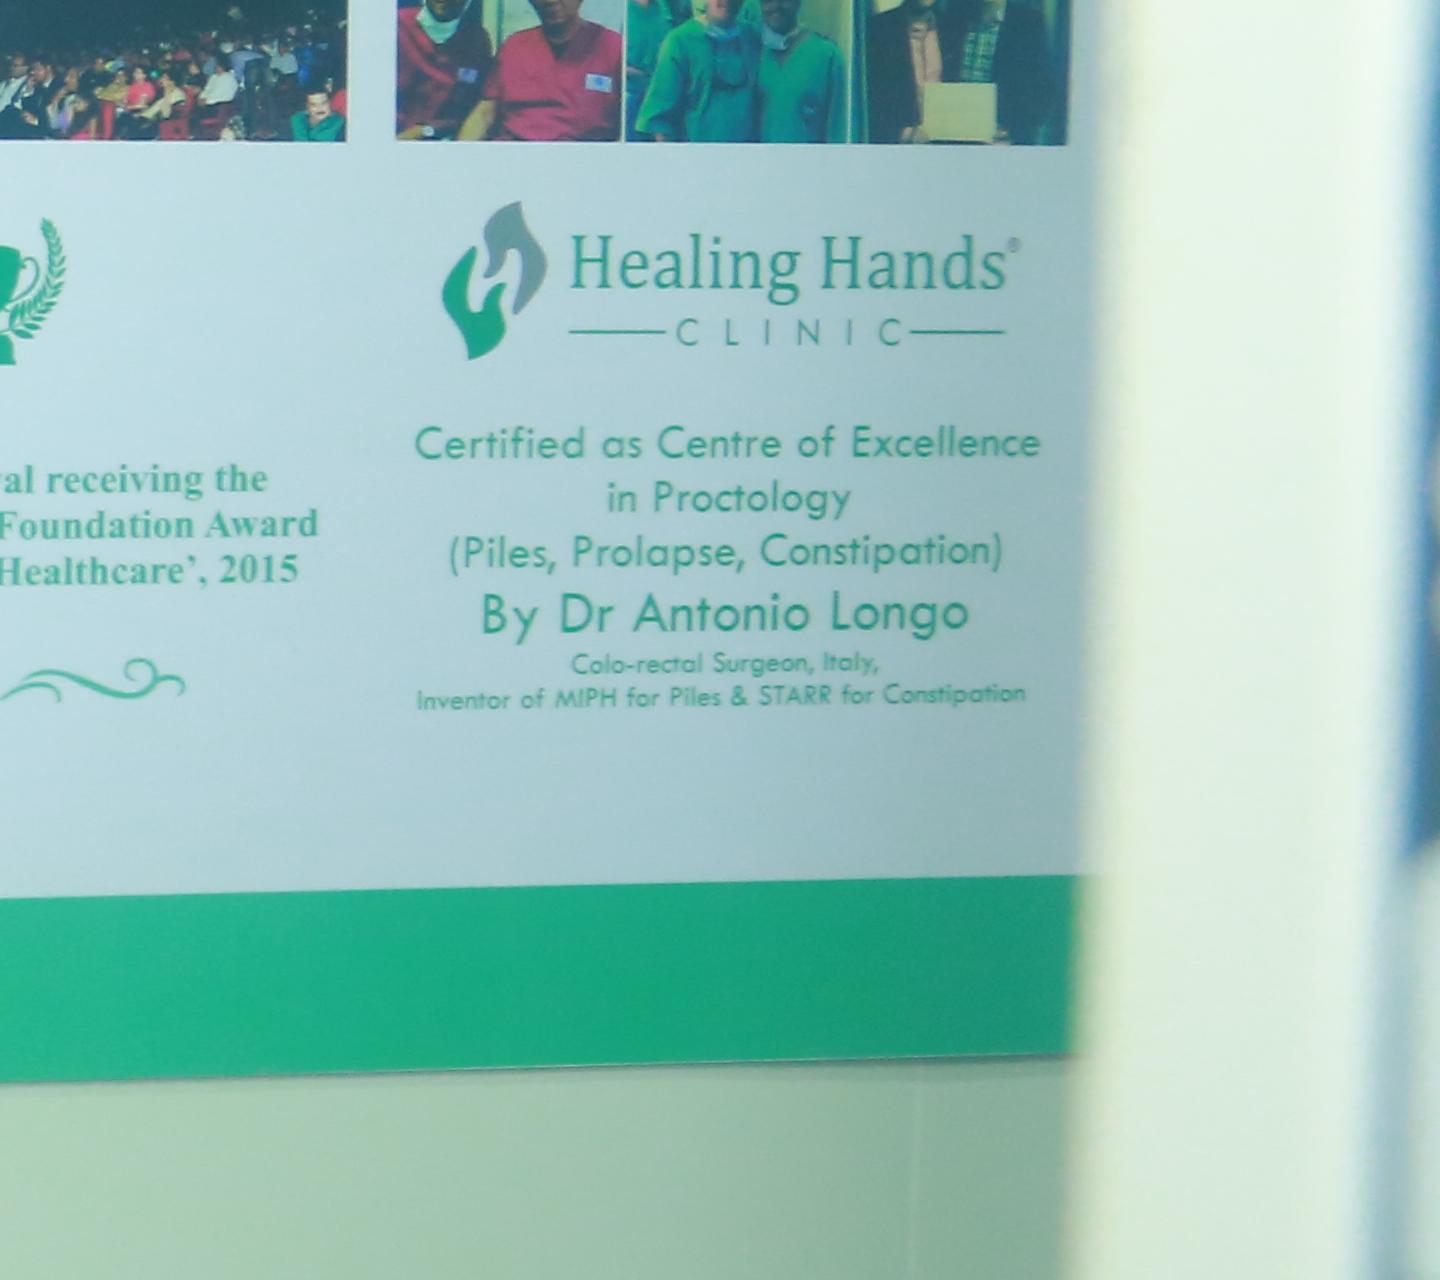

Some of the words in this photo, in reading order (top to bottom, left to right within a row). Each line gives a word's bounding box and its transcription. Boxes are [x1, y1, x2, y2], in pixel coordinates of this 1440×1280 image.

[571, 233, 802, 306] Healing
[822, 234, 1006, 290] Hands
[676, 316, 901, 347] CLINIC
[415, 426, 585, 460] Certified
[602, 437, 642, 459] as
[658, 425, 782, 459] Centre
[798, 424, 835, 458] of
[853, 425, 1041, 458] Excellence
[48, 464, 203, 502] receiving
[215, 464, 268, 492] the
[608, 482, 637, 512] in
[655, 480, 851, 521] Proctology
[205, 508, 318, 538] Award
[220, 554, 298, 583] 2015
[450, 536, 556, 576] (Piles,
[574, 535, 745, 575] Prolapse,
[761, 532, 1002, 573] Constipation)
[483, 593, 538, 645] By
[561, 593, 614, 633] Dr
[633, 592, 811, 632] Antonio
[832, 591, 969, 641] Longo
[571, 653, 703, 675] Colo-rectal
[713, 651, 815, 678] Surgeon,
[823, 651, 879, 676] Italy,
[417, 691, 511, 711] Inventor
[520, 688, 545, 709] of
[555, 687, 617, 708] MIPH
[626, 686, 660, 708] for
[670, 686, 722, 707] Piles
[730, 685, 748, 707] &
[759, 684, 832, 706] STARR
[841, 684, 874, 705] for
[883, 683, 1026, 707] Constipation
